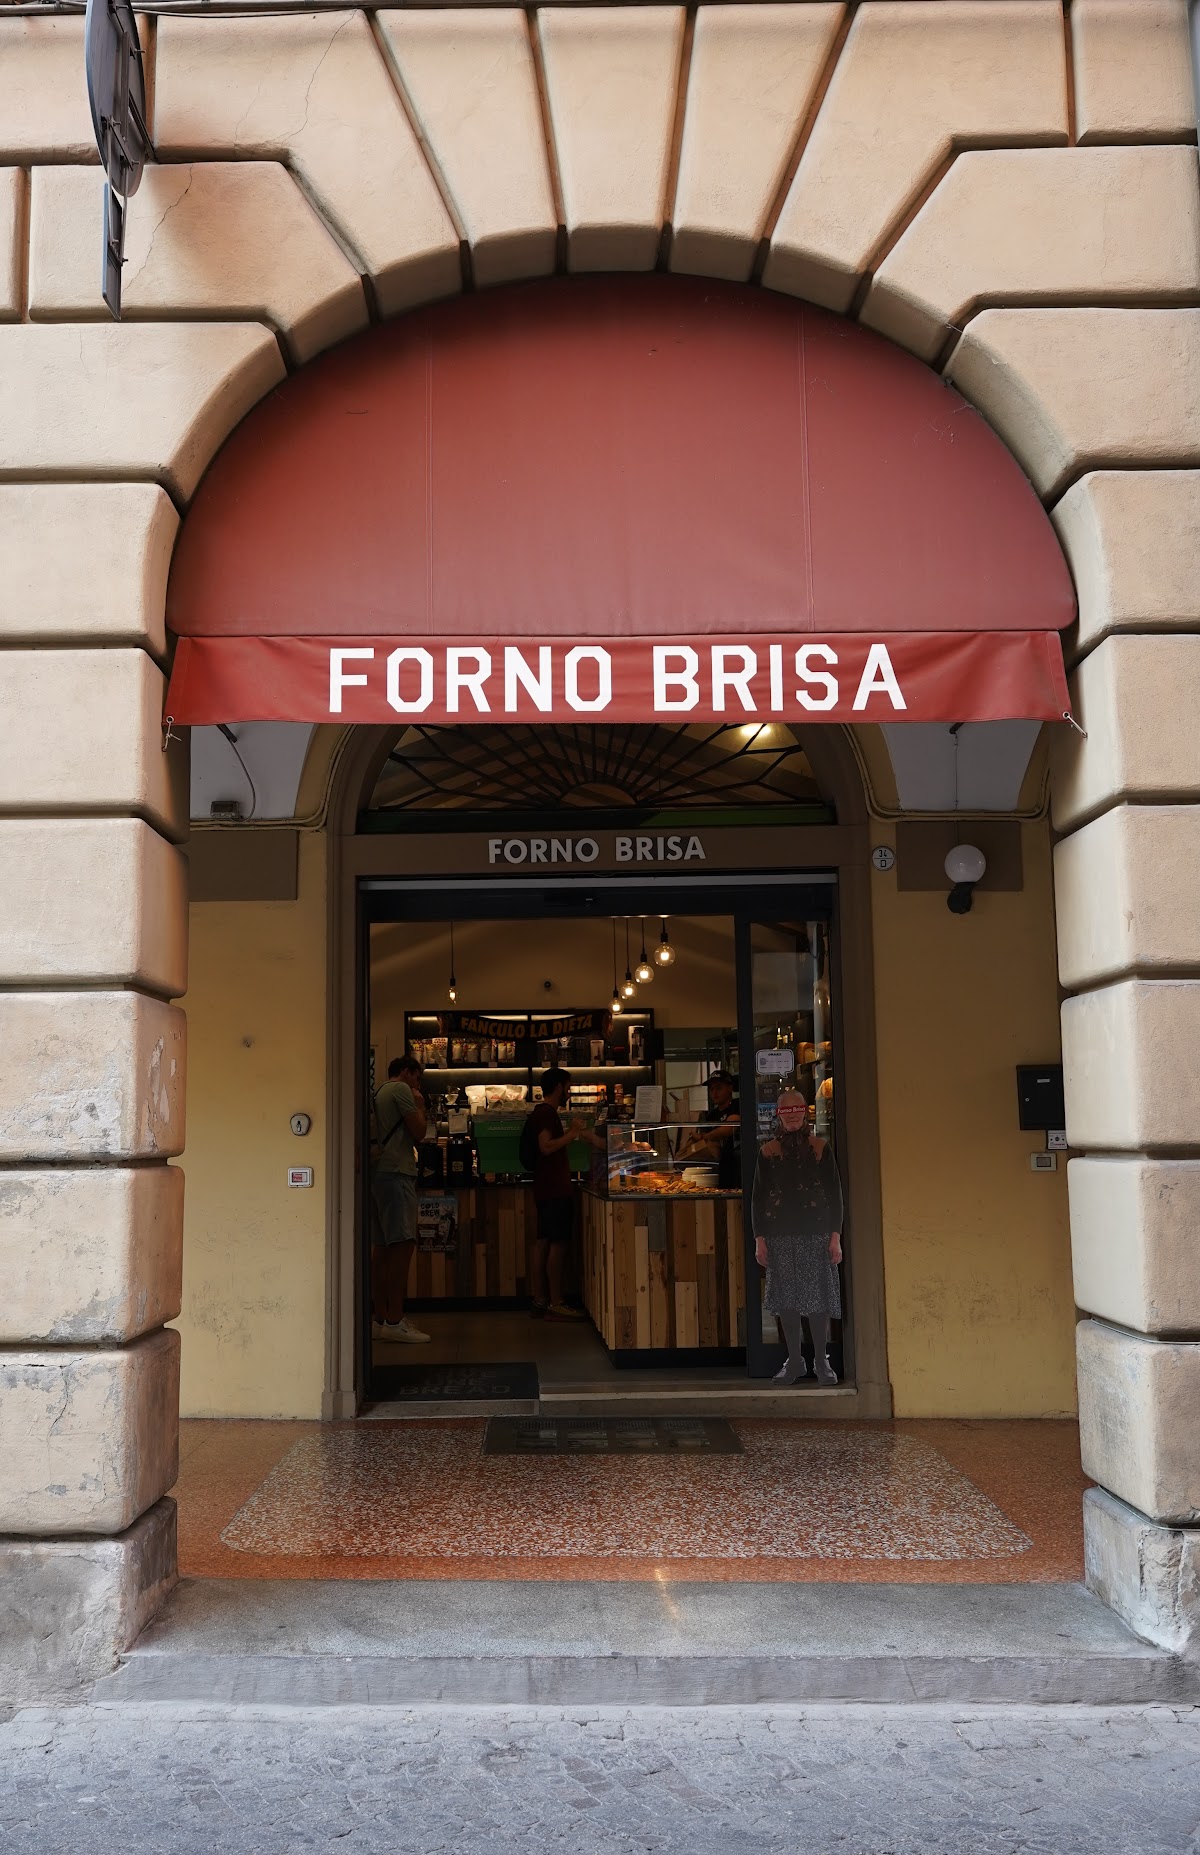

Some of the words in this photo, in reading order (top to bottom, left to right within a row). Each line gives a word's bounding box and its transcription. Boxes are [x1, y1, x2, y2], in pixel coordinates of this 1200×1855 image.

[329, 646, 612, 713] FORNO
[652, 643, 908, 712] BRISA
[488, 837, 600, 864] FORNO
[615, 835, 706, 862] BRISA
[460, 1016, 526, 1039] FANCULO
[529, 1023, 549, 1038] LA
[552, 1014, 593, 1034] DIETA
[420, 1209, 440, 1217] BREW
